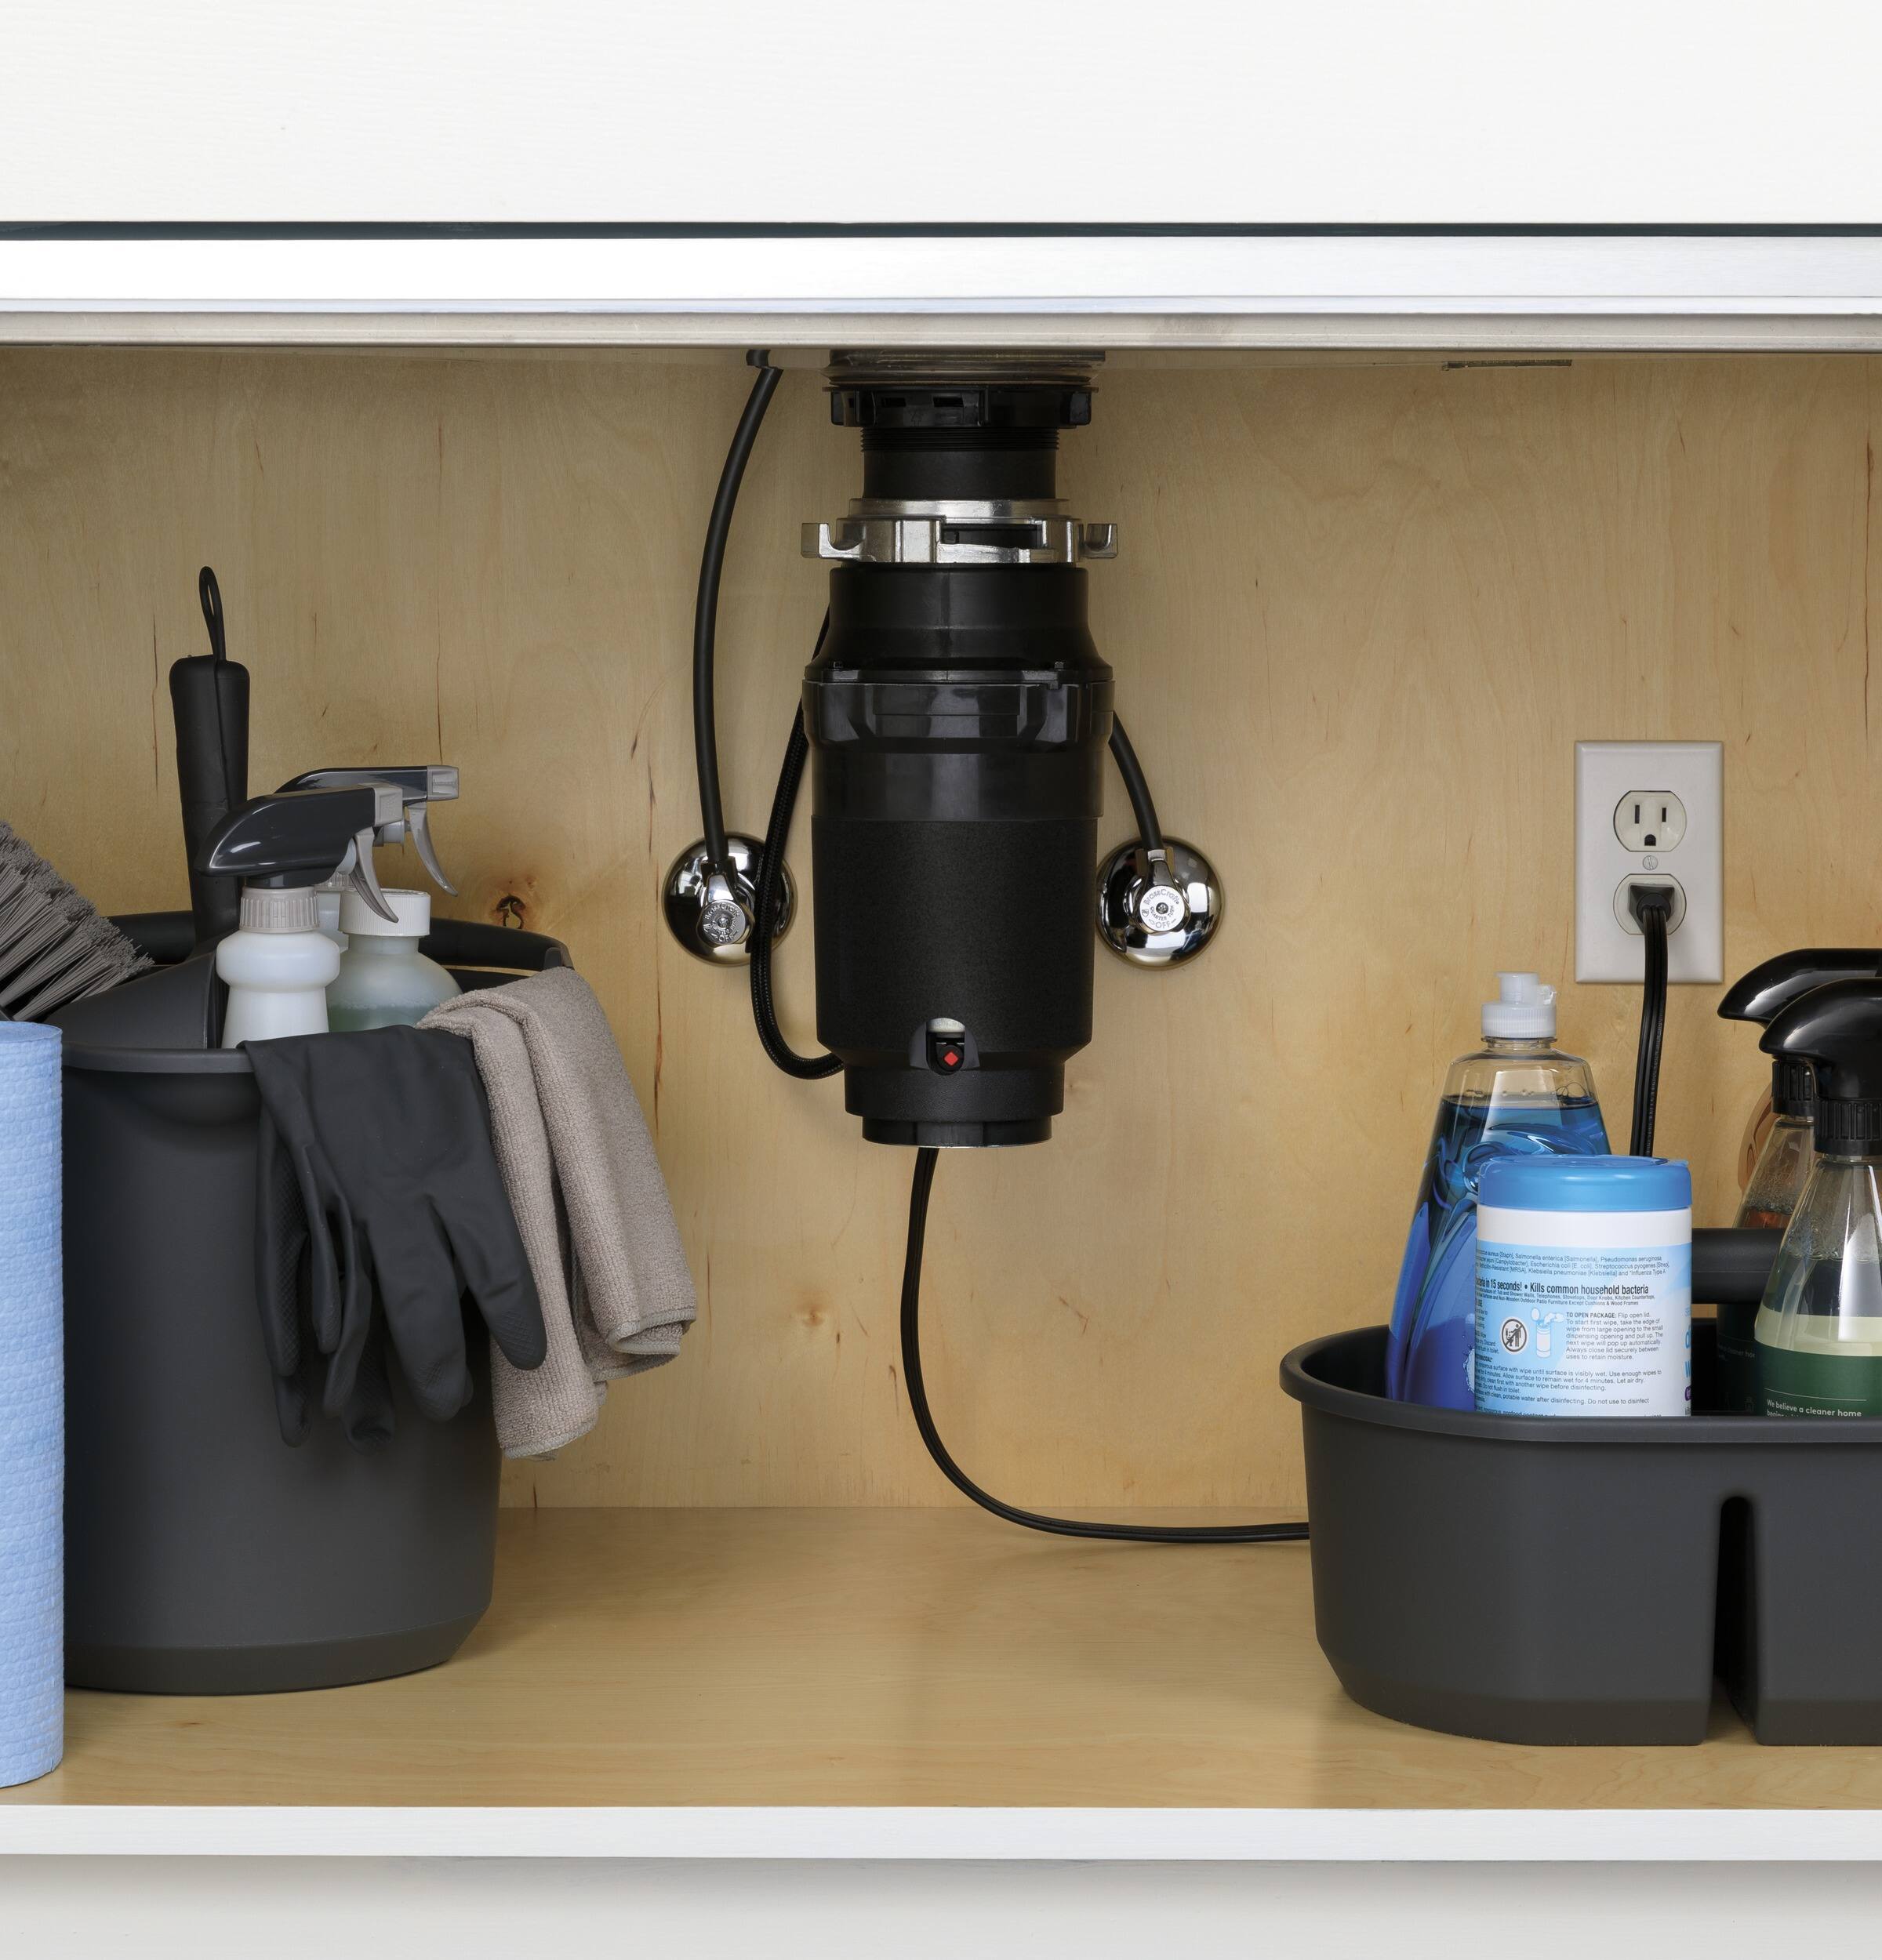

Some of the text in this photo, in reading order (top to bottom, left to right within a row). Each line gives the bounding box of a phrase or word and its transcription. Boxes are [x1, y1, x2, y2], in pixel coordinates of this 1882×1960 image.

[1491, 1279, 1497, 1290] 15
[1497, 1281, 1522, 1291] seconds!
[1530, 1283, 1545, 1293] Kills
[1546, 1286, 1579, 1294] common
[1581, 1284, 1620, 1294] household
[1622, 1284, 1648, 1294] bacteria
[1550, 1397, 1586, 1406] disinfecting.
[1767, 1399, 1775, 1407] We
[1776, 1403, 1797, 1412] believe
[1805, 1406, 1835, 1416] cleaner
[1837, 1409, 1862, 1417] home
